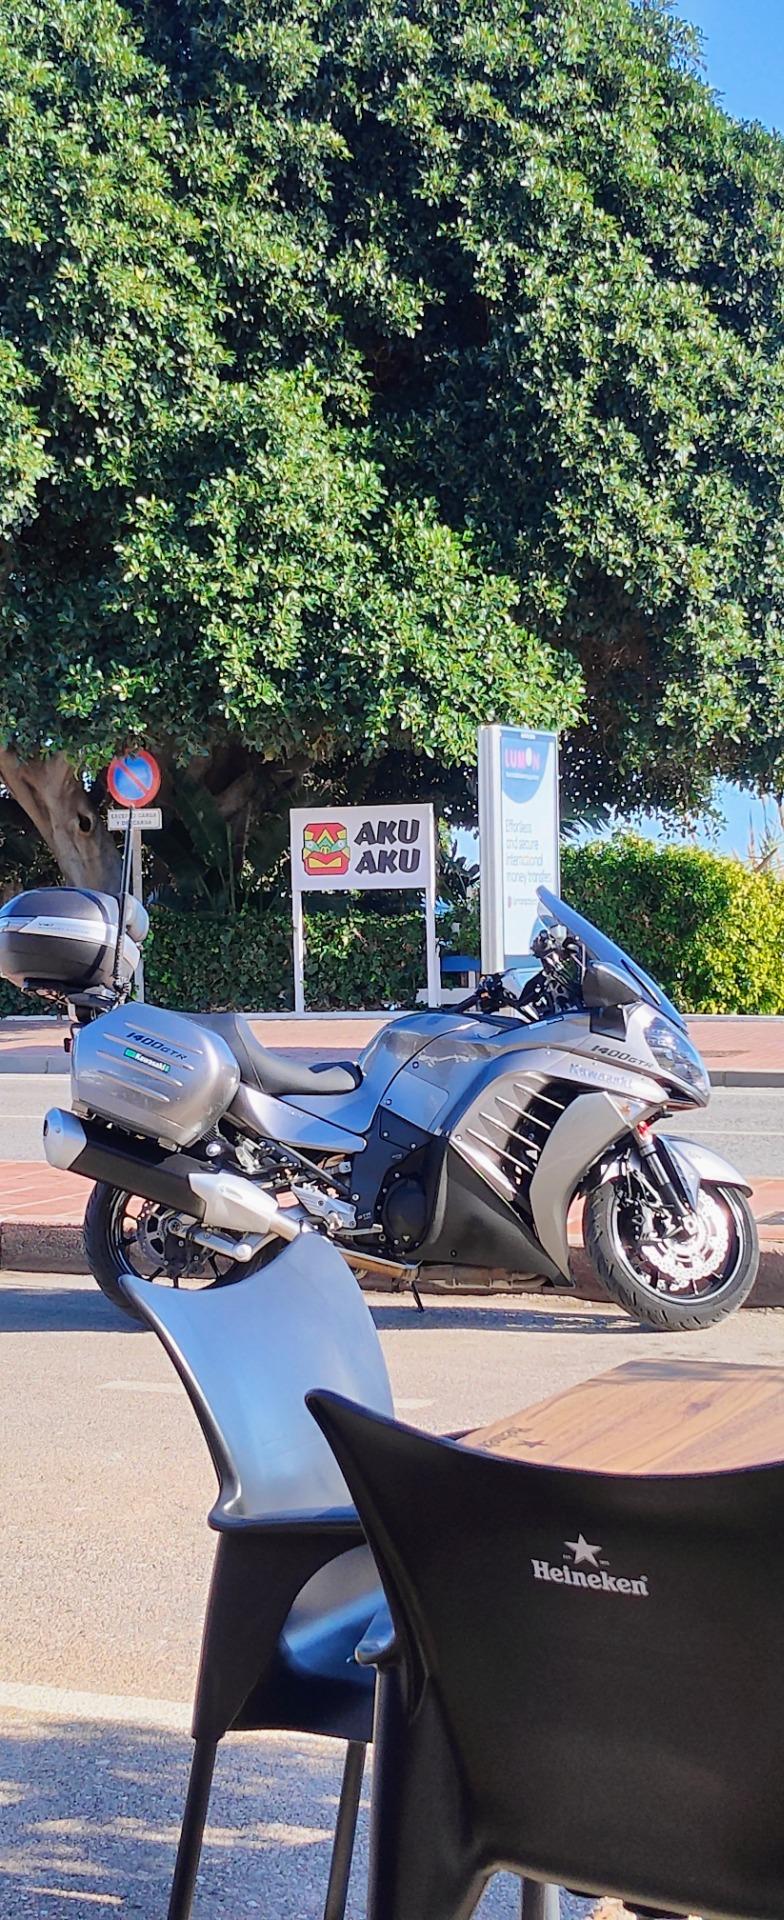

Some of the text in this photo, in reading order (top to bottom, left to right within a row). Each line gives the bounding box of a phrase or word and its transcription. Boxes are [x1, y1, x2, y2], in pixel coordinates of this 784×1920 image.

[504, 747, 541, 770] LUMON
[354, 819, 420, 845] AKU
[354, 848, 421, 874] AKU
[126, 1032, 188, 1060] 1400GTR
[590, 1045, 654, 1068] 1400GTR
[531, 1559, 649, 1596] Heineken
